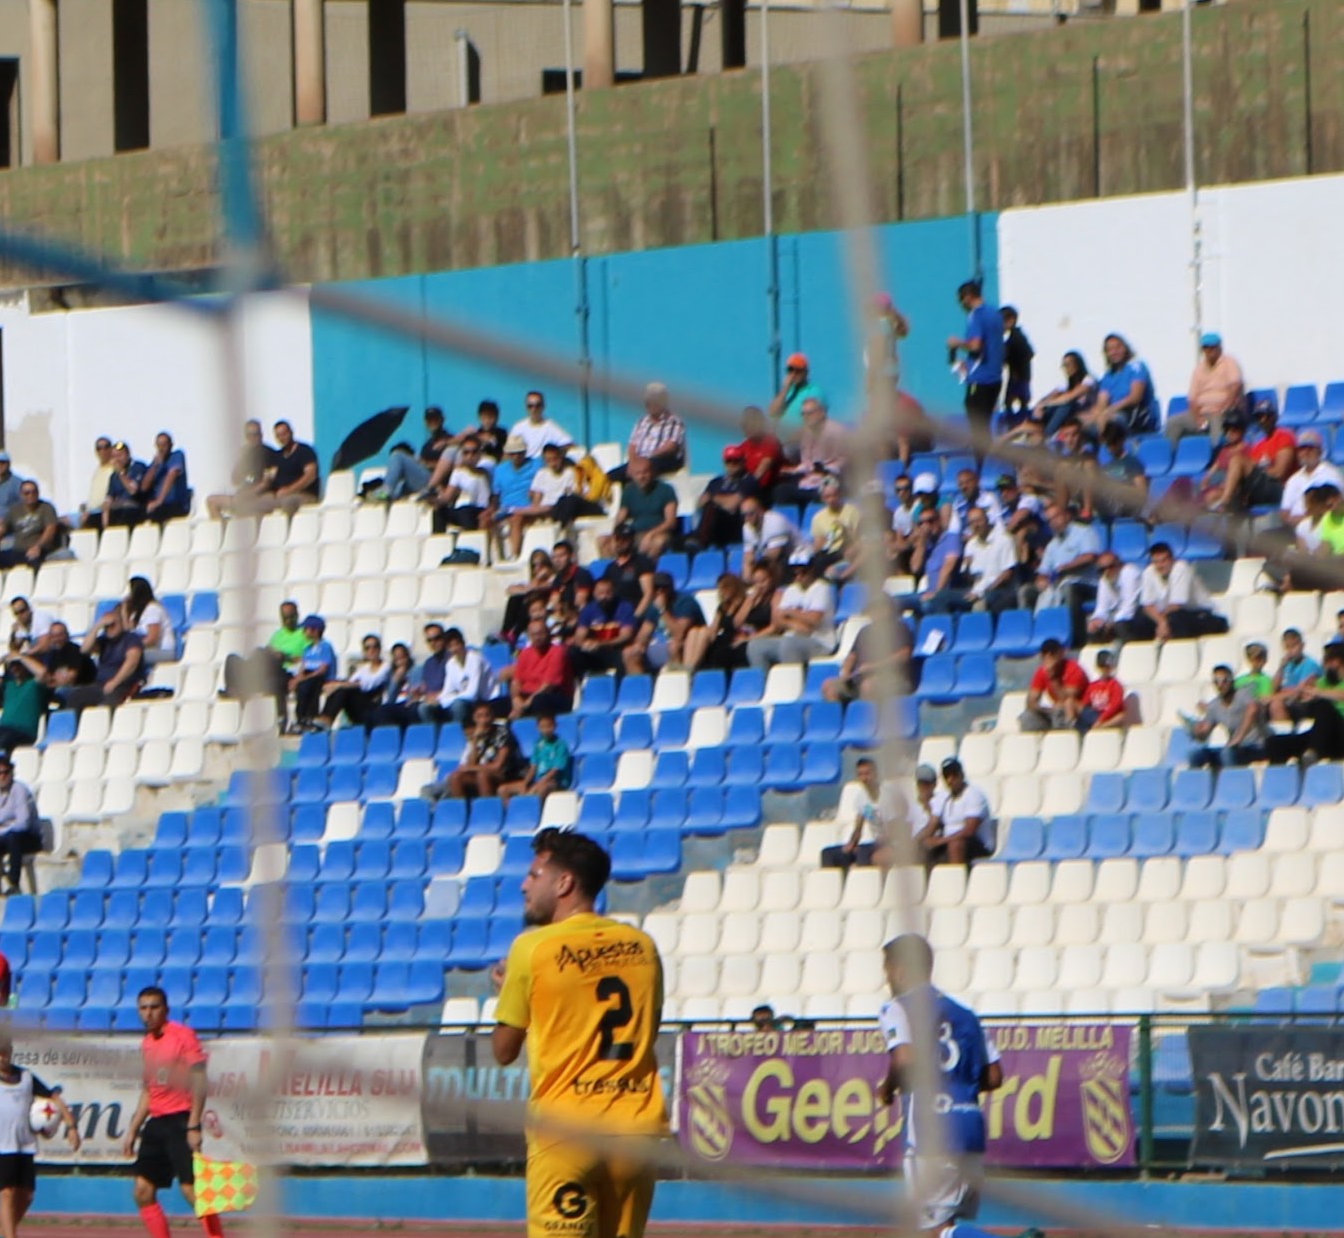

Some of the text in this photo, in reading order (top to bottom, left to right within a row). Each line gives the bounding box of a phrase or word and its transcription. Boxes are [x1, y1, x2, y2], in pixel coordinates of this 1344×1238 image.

[595, 976, 633, 1061] 2
[707, 1032, 780, 1056] TROFEO
[782, 1032, 845, 1056] MEJOR
[1035, 1026, 1115, 1049] MELILLA
[1254, 1051, 1305, 1082] Café
[370, 1069, 417, 1096] SLU
